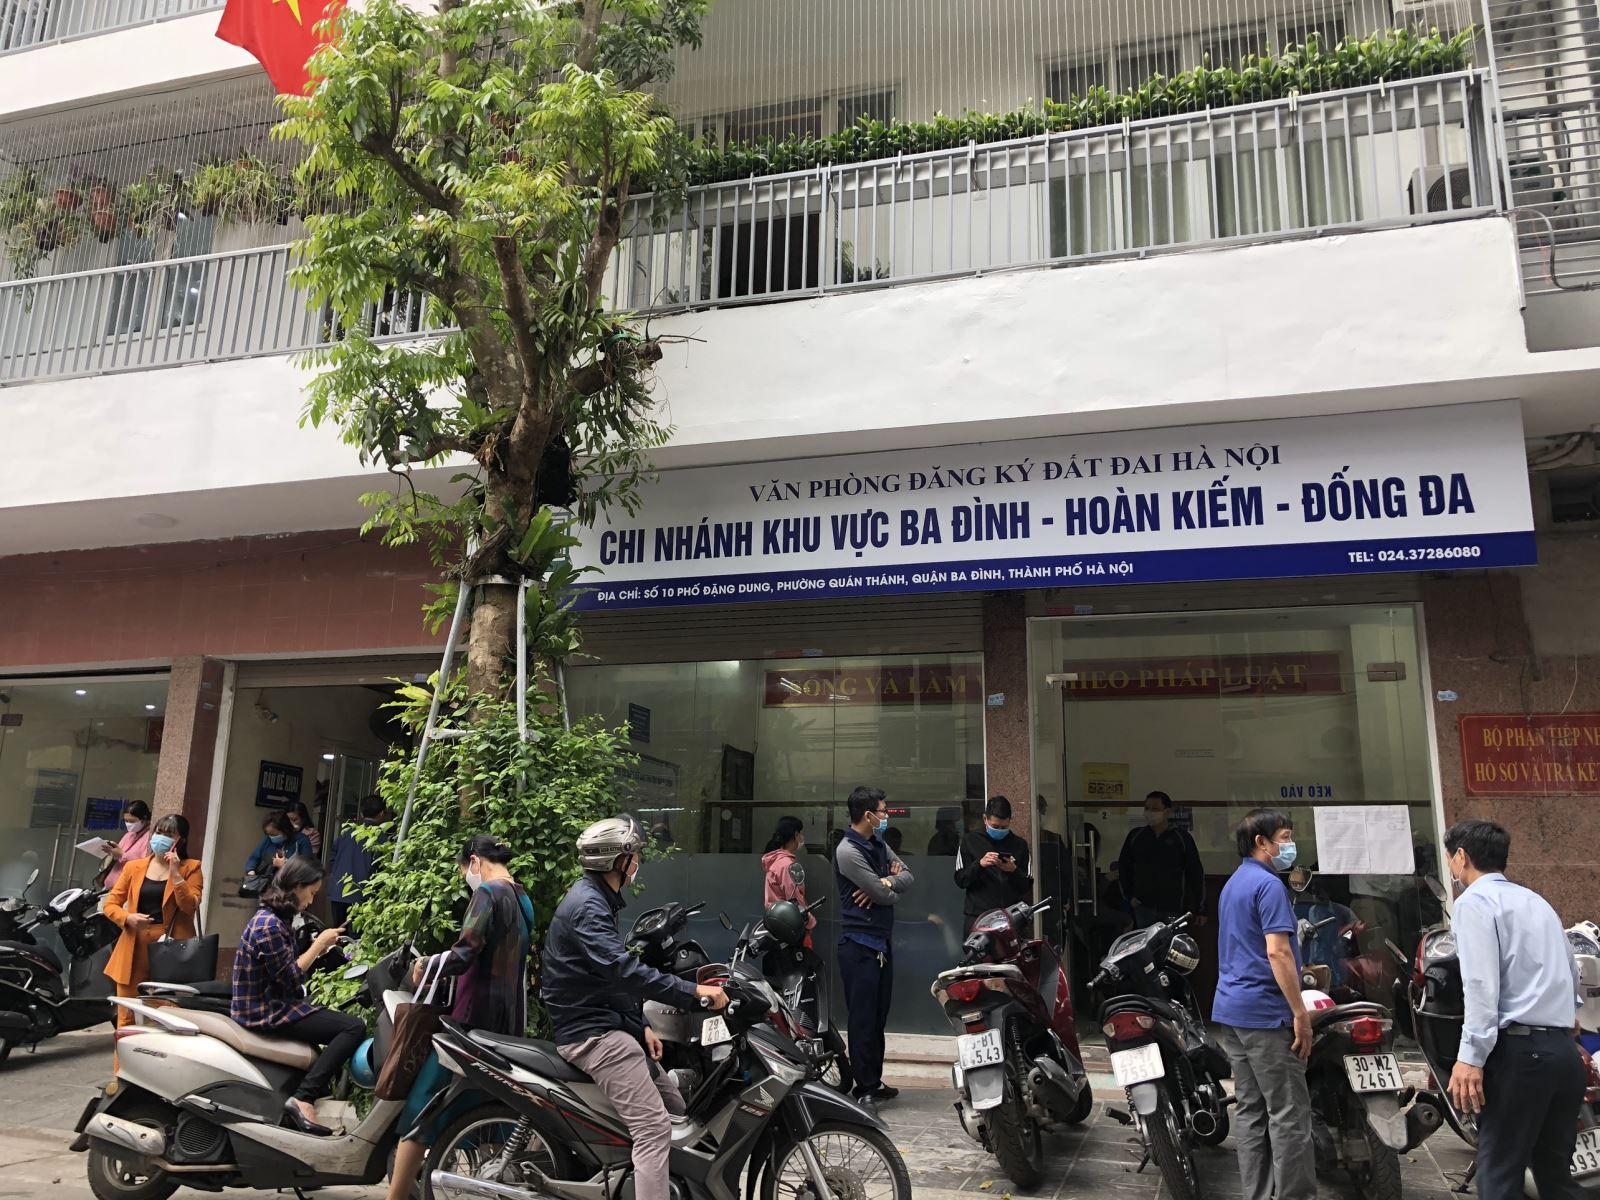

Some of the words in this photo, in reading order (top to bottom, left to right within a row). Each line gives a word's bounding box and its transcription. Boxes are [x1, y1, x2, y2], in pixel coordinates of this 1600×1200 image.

[749, 478, 802, 503] VĂN
[808, 472, 901, 499] PHÒNG
[907, 466, 987, 491] ĐĂNG
[995, 459, 1034, 484] KÝ
[1043, 454, 1103, 480] ĐẤT
[1111, 454, 1163, 475] ĐAI
[1172, 445, 1217, 472] HÀ
[1223, 443, 1281, 472] NỘI
[599, 529, 645, 566] CHI
[654, 517, 753, 561] NHÁNH
[762, 516, 821, 555] KHU
[831, 508, 889, 558] VỰC
[900, 508, 942, 546] BA
[951, 497, 1030, 543] ĐÌNH
[1066, 487, 1161, 536] HOÀN
[1172, 476, 1265, 530] KIẾM
[1301, 467, 1407, 523] ĐỐNG
[1419, 473, 1475, 516] ĐA
[1347, 551, 1375, 563] TEL:
[1377, 545, 1481, 562] 024.37286080
[597, 591, 616, 603] ĐỊA
[618, 587, 642, 600] CHỈ:
[643, 586, 660, 598] SỐ
[662, 588, 675, 598] 10
[677, 583, 701, 597] PHỐ
[703, 584, 736, 598] ĐẶNG
[738, 582, 774, 594] DUNG,
[776, 578, 826, 591] PHƯỜNG
[828, 575, 863, 588] QUÁN
[865, 573, 909, 586] THÁNH,
[911, 570, 948, 585] QUẬN
[950, 571, 968, 582] BA
[970, 568, 1005, 581] ĐÌNH,
[1008, 566, 1051, 579] THÀNH
[1054, 562, 1083, 576] PHỐ
[1086, 562, 1106, 575] HÀ
[1109, 561, 1134, 576] NỘI
[865, 670, 898, 694] VÀ
[908, 669, 968, 694] LÀM
[1139, 661, 1217, 688] PHÁP
[1223, 662, 1307, 691] LUẬT
[1482, 725, 1503, 752] BỘ
[1506, 727, 1546, 752] PHẬN
[1548, 722, 1581, 746] TIẾP
[1474, 757, 1497, 782] HỒ
[1499, 760, 1518, 781] SƠ
[1520, 757, 1541, 781] VÀ
[1577, 756, 1600, 781] KẾ
[1352, 1055, 1393, 1072] 30-M2
[1357, 1072, 1396, 1090] 2461
